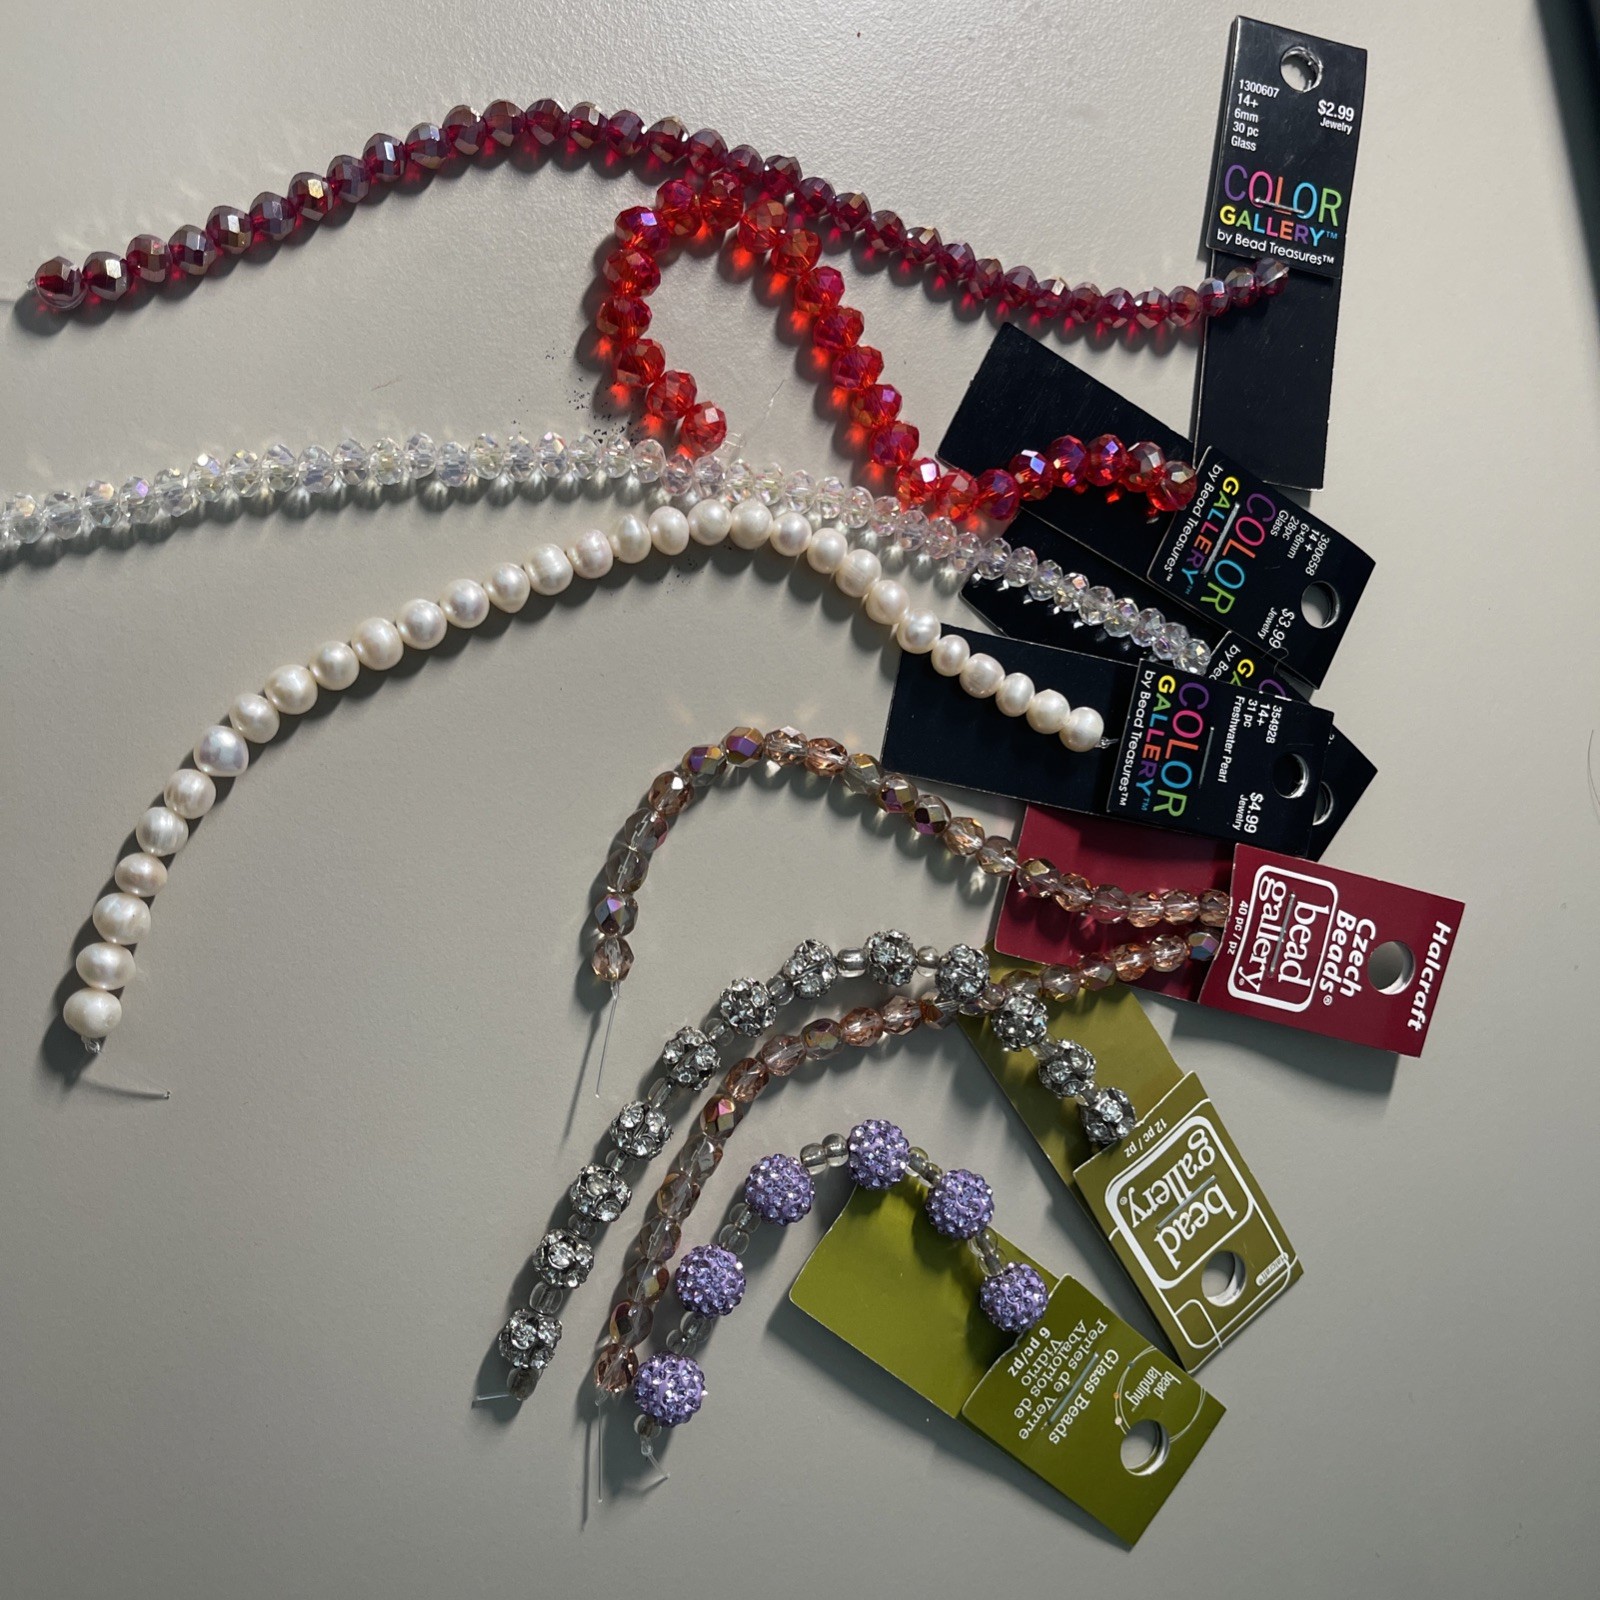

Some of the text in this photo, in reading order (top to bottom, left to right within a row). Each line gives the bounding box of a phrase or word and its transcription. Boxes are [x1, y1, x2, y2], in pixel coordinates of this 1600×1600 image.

[1237, 94, 1258, 108] 14+
[1239, 79, 1280, 98] 1300607
[1234, 108, 1258, 123] 6mm
[1318, 100, 1354, 122] $2.99
[1320, 118, 1352, 135] Jewelry
[1231, 136, 1256, 151] Glass
[1233, 122, 1259, 137] 30 pc
[1224, 164, 1342, 227] COLOR
[1217, 229, 1232, 245] by
[1235, 234, 1266, 252] Bead
[1208, 464, 1223, 483] by
[1192, 482, 1214, 519] Bead
[1271, 510, 1288, 536] Glass
[1282, 516, 1299, 540] 28pc
[1200, 493, 1276, 614] COLOR
[1305, 534, 1330, 576] 390658
[1257, 607, 1277, 640] Jewelry
[1269, 608, 1295, 649] $3.99
[1140, 670, 1156, 687] by
[1209, 644, 1241, 681] by Be
[1134, 692, 1150, 729] Bead
[1226, 695, 1245, 751] Freshwater
[1243, 699, 1258, 728] 31 pc
[1256, 704, 1270, 726] 14+
[1266, 705, 1282, 744] 354928
[1153, 682, 1210, 817] COLOR
[1218, 750, 1232, 783] Pearl
[1232, 794, 1246, 831] Jewelry
[1244, 792, 1264, 834] $4.99
[1235, 917, 1243, 932] pc
[1238, 900, 1248, 916] 40
[1227, 941, 1237, 956] pz
[1277, 901, 1330, 987] bead
[1339, 918, 1376, 997] Czech
[1407, 920, 1451, 1032] Halcraft
[1143, 1127, 1157, 1143] pc
[1154, 1118, 1167, 1133] 12
[1124, 1142, 1136, 1158] pz
[1154, 1184, 1237, 1271] bead
[1007, 1327, 1051, 1377] 6 pc/pz
[1021, 1338, 1063, 1386] Vidrio
[1013, 1319, 1087, 1419] Abalorios de
[1018, 1318, 1108, 1440] Perles de Verre
[1153, 1371, 1182, 1400] bead
[1048, 1349, 1119, 1445] Glass Beads
